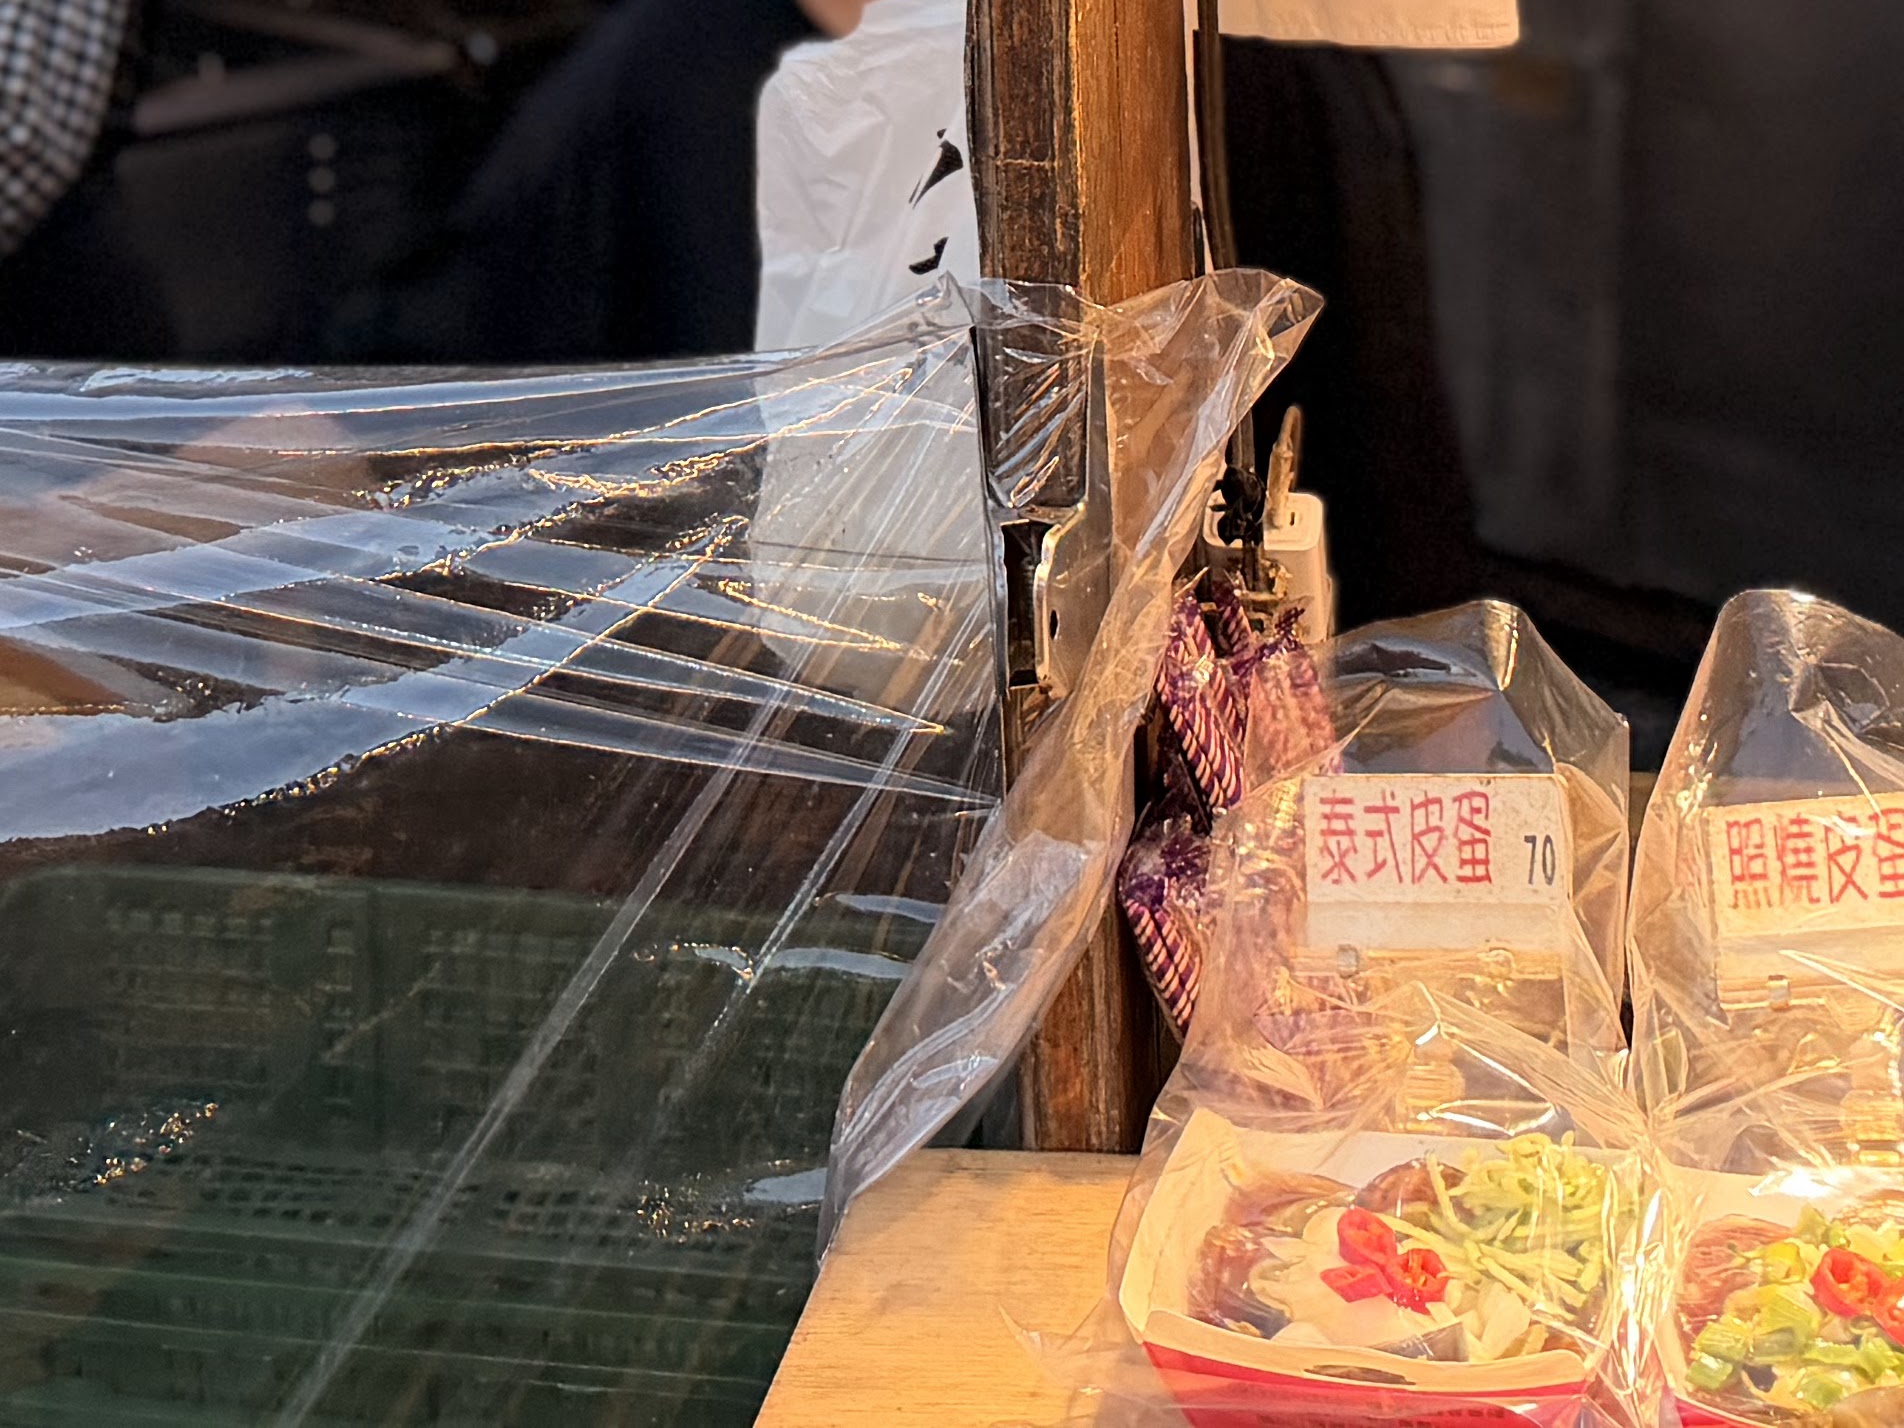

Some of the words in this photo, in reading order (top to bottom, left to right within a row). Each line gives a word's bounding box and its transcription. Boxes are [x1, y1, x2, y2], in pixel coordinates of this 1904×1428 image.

[1318, 787, 1494, 886] 泰式皮蛋
[1523, 833, 1557, 886] 70
